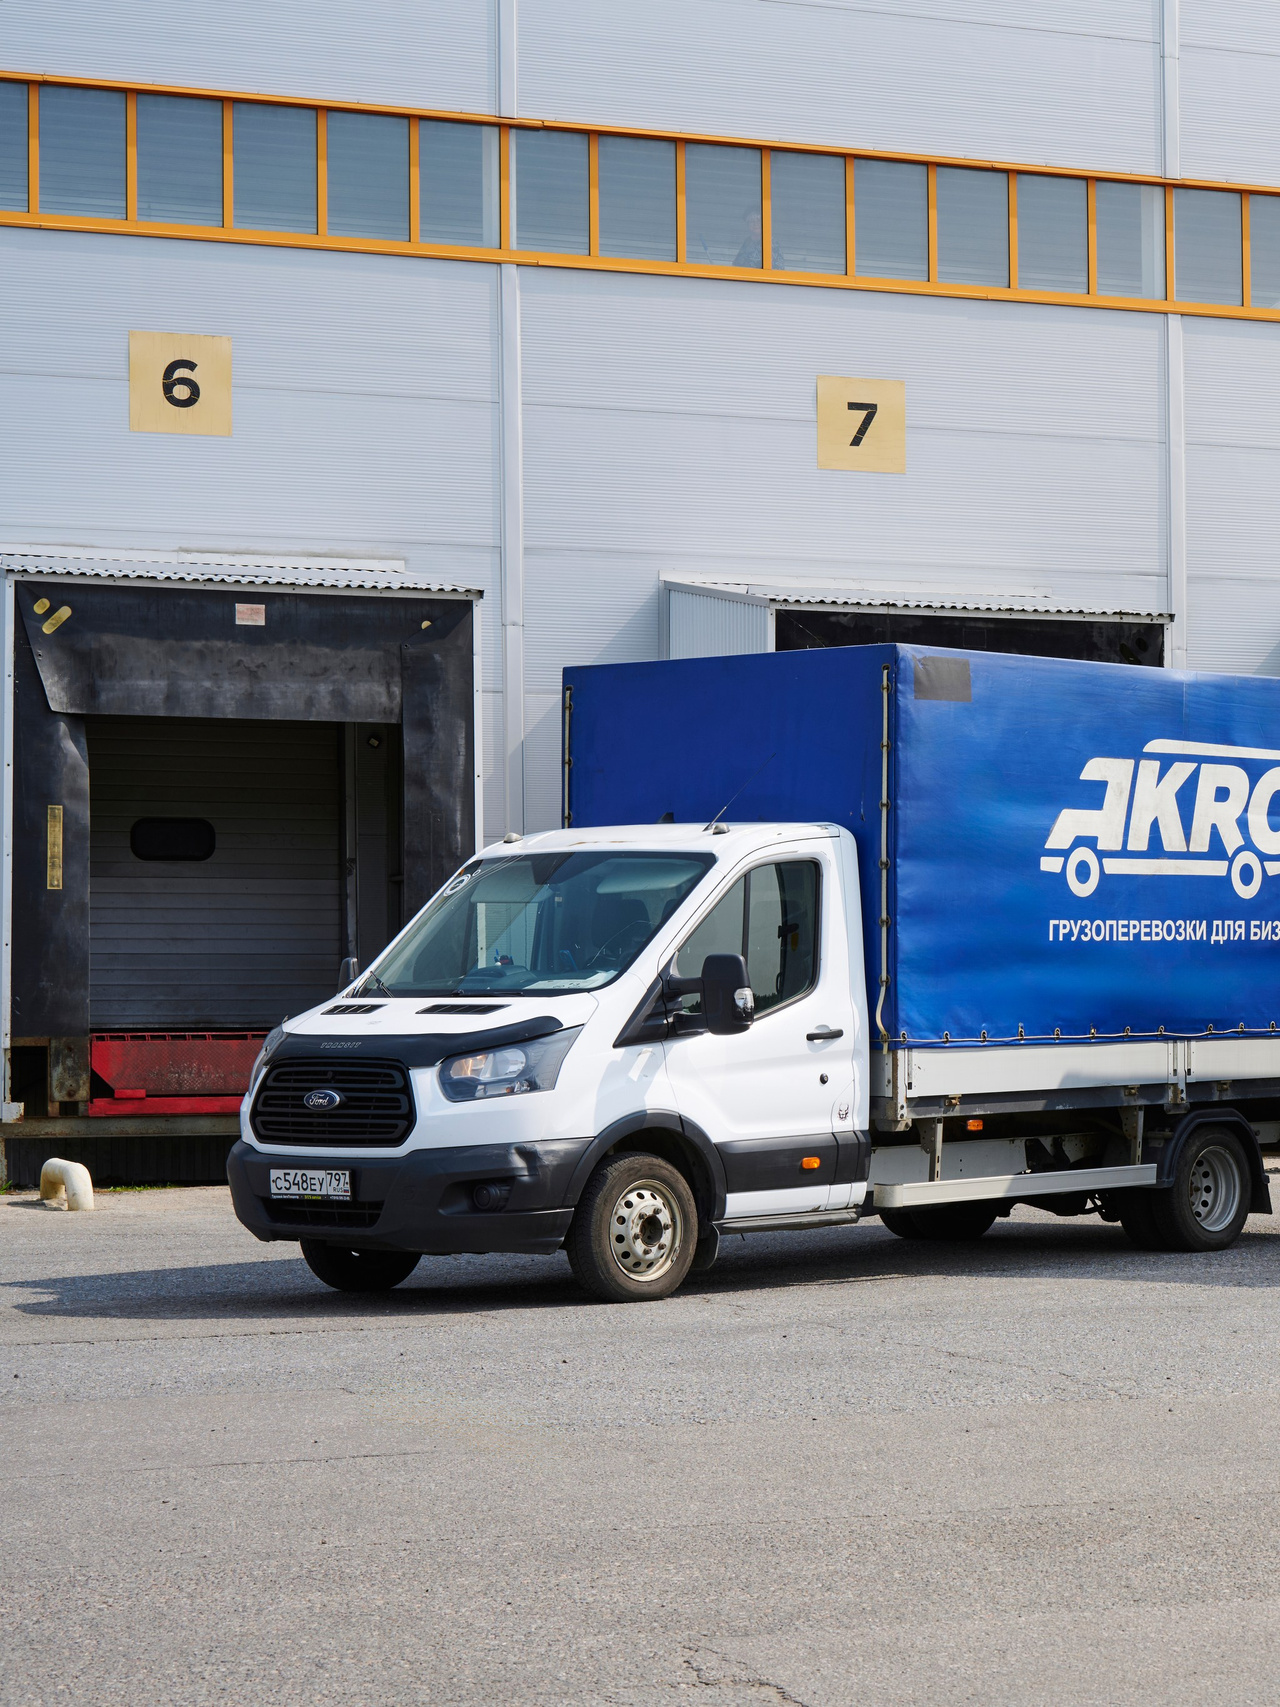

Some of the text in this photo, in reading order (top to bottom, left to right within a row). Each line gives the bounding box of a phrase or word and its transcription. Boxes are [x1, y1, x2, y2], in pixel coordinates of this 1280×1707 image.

[162, 359, 200, 408] 6
[847, 402, 878, 447] 7
[1049, 919, 1207, 942] ГРУЗОПЕРЕВОЗКИ
[1211, 920, 1246, 944] ДЛЯ
[309, 1093, 329, 1106] Ford
[327, 1172, 347, 1187] 797
